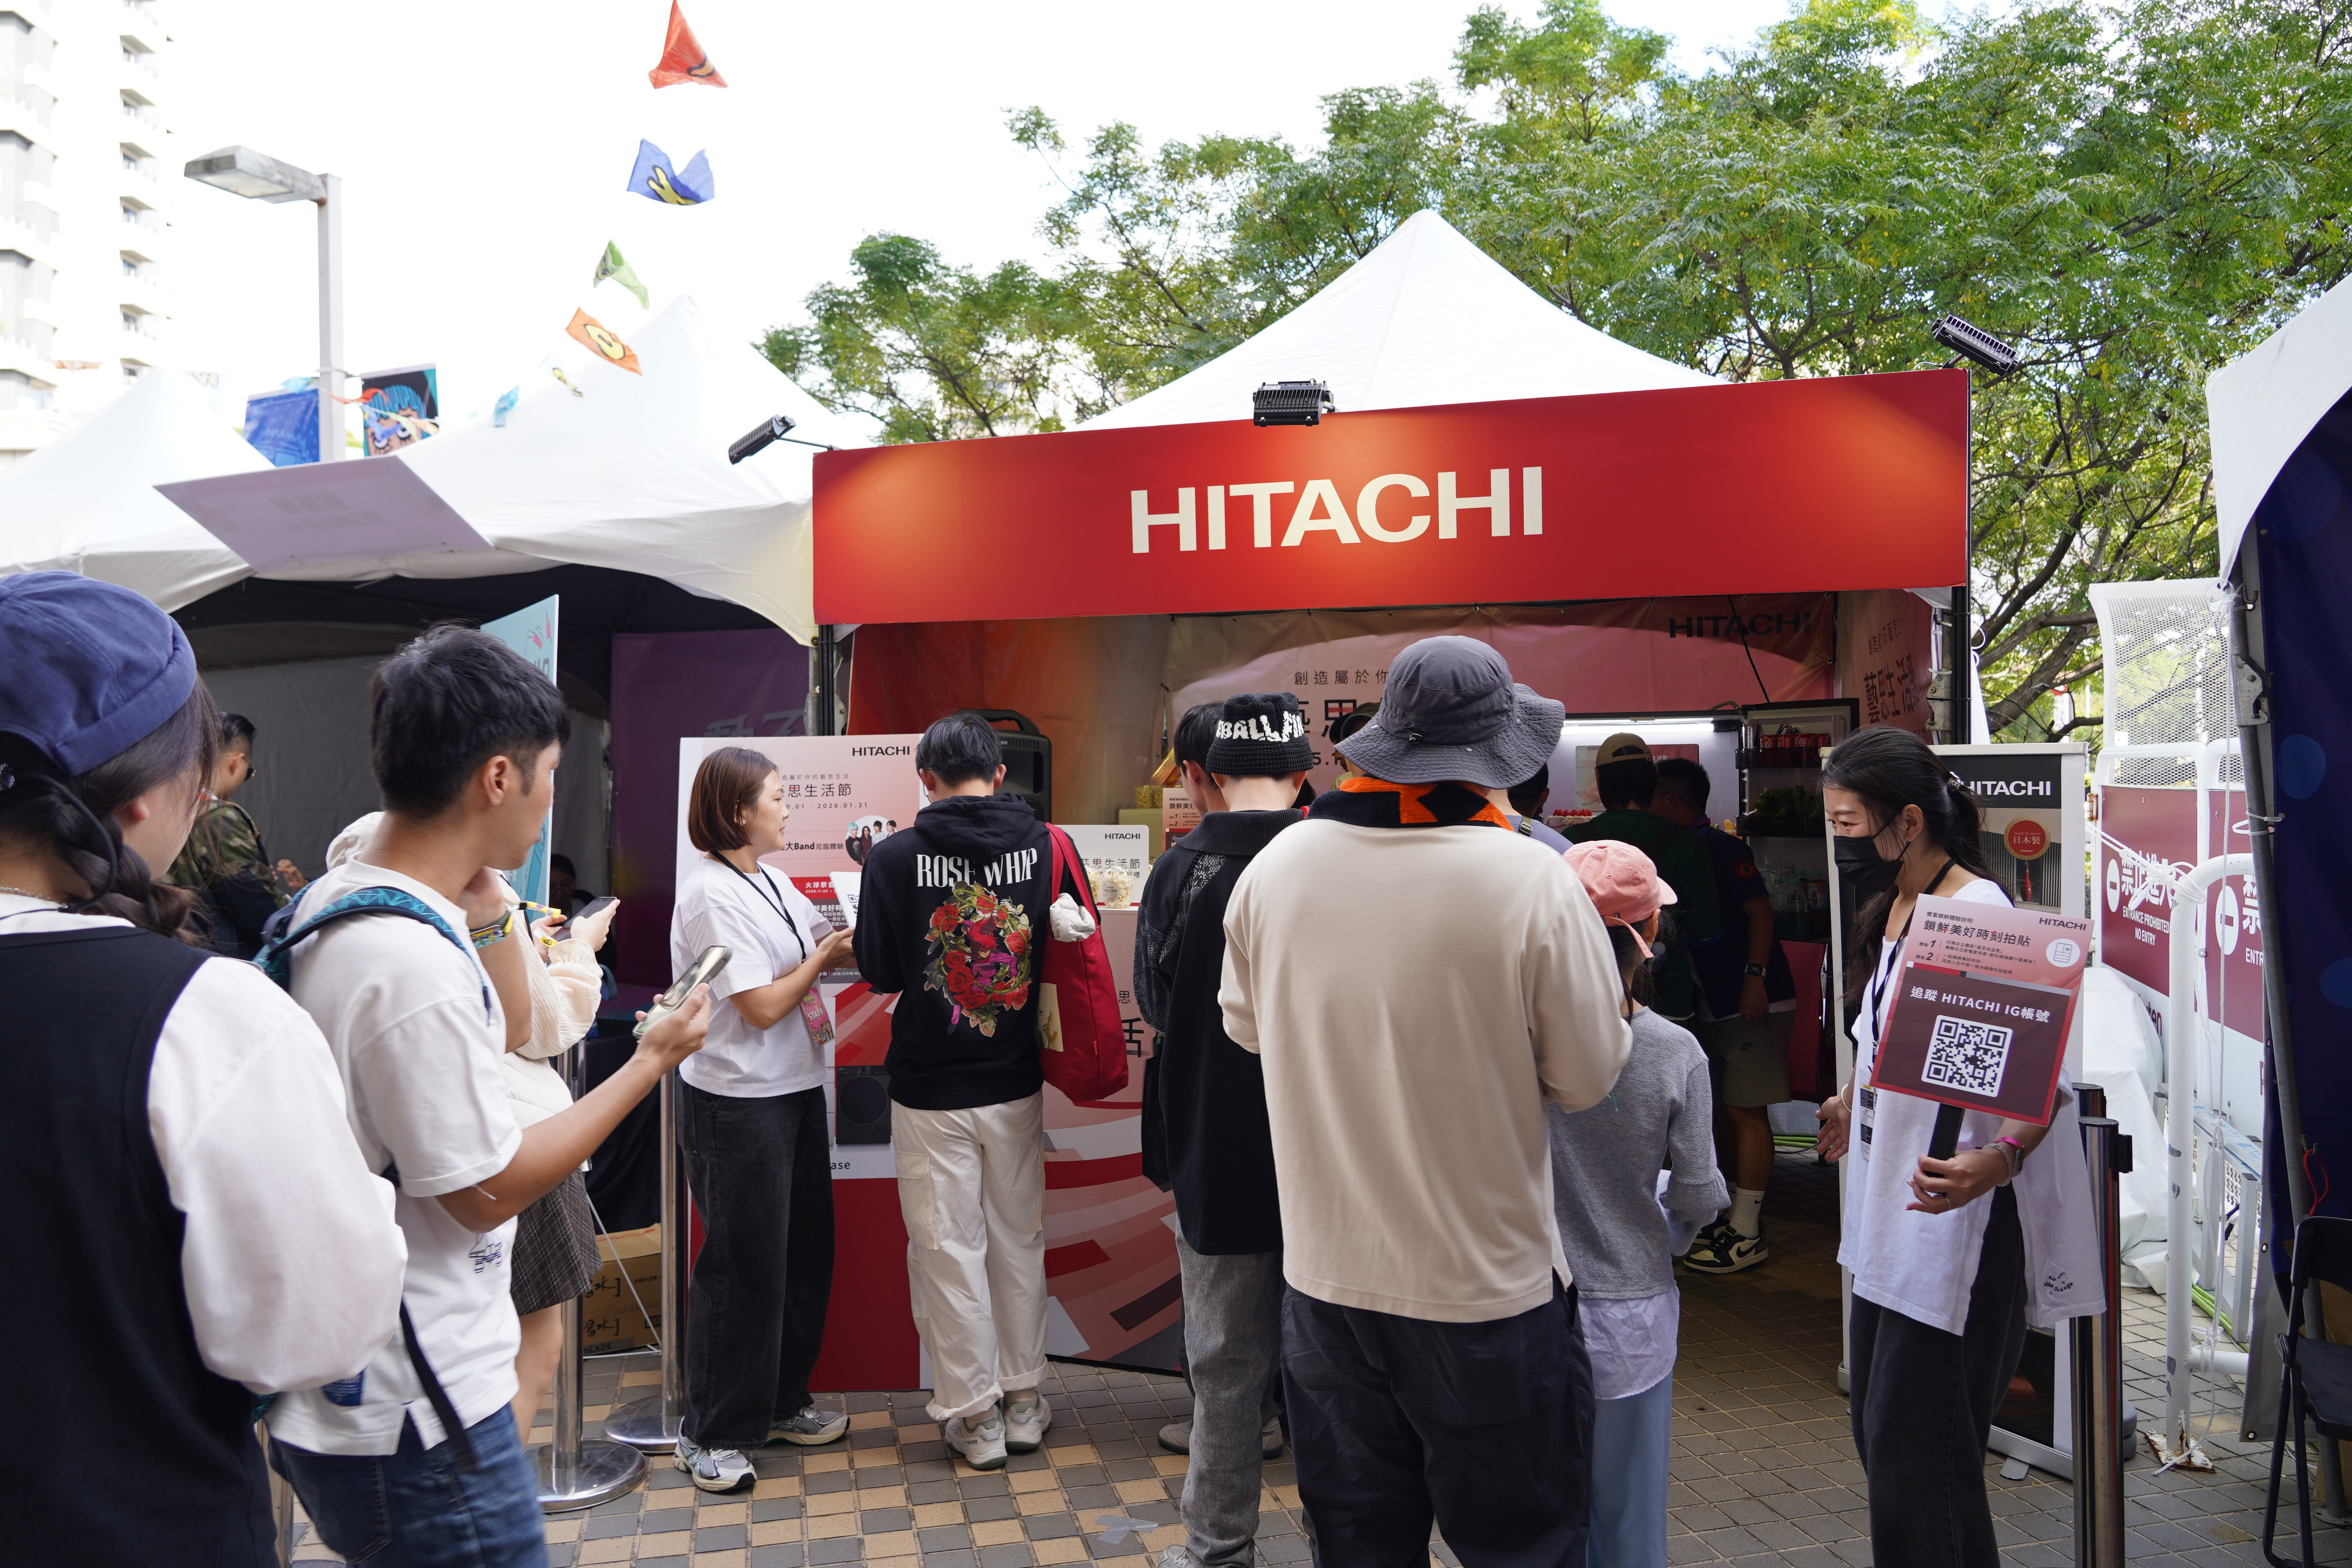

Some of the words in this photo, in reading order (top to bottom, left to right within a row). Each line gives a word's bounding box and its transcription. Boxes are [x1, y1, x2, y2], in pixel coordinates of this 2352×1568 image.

[1131, 466, 1544, 554] HITACHI
[1670, 611, 1812, 638] HITACHI
[852, 746, 910, 757] HITACHI
[1961, 780, 2051, 796] HITACHI
[780, 841, 844, 851] 大Band蒞臨體驗
[2014, 835, 2040, 844] 日本製
[916, 854, 976, 888] ROSE
[2039, 917, 2087, 931] HITACHI
[2123, 906, 2144, 925] ENTRANCE
[2144, 912, 2170, 933] PROHIBITED
[1923, 920, 2031, 947] 鎖鮮美好時刻拍貼
[2135, 927, 2141, 941] NO
[2142, 929, 2156, 946] ENTRY
[1930, 940, 1936, 948] 1
[1925, 952, 1934, 961] 2
[1118, 991, 1131, 1004] 思
[1910, 986, 1938, 1002] 追蹤
[1941, 993, 2001, 1013] HITACHI
[2005, 1004, 2050, 1023] IG帳號
[808, 1008, 823, 1021] STAFF
[2054, 1282, 2074, 1293] Orange
